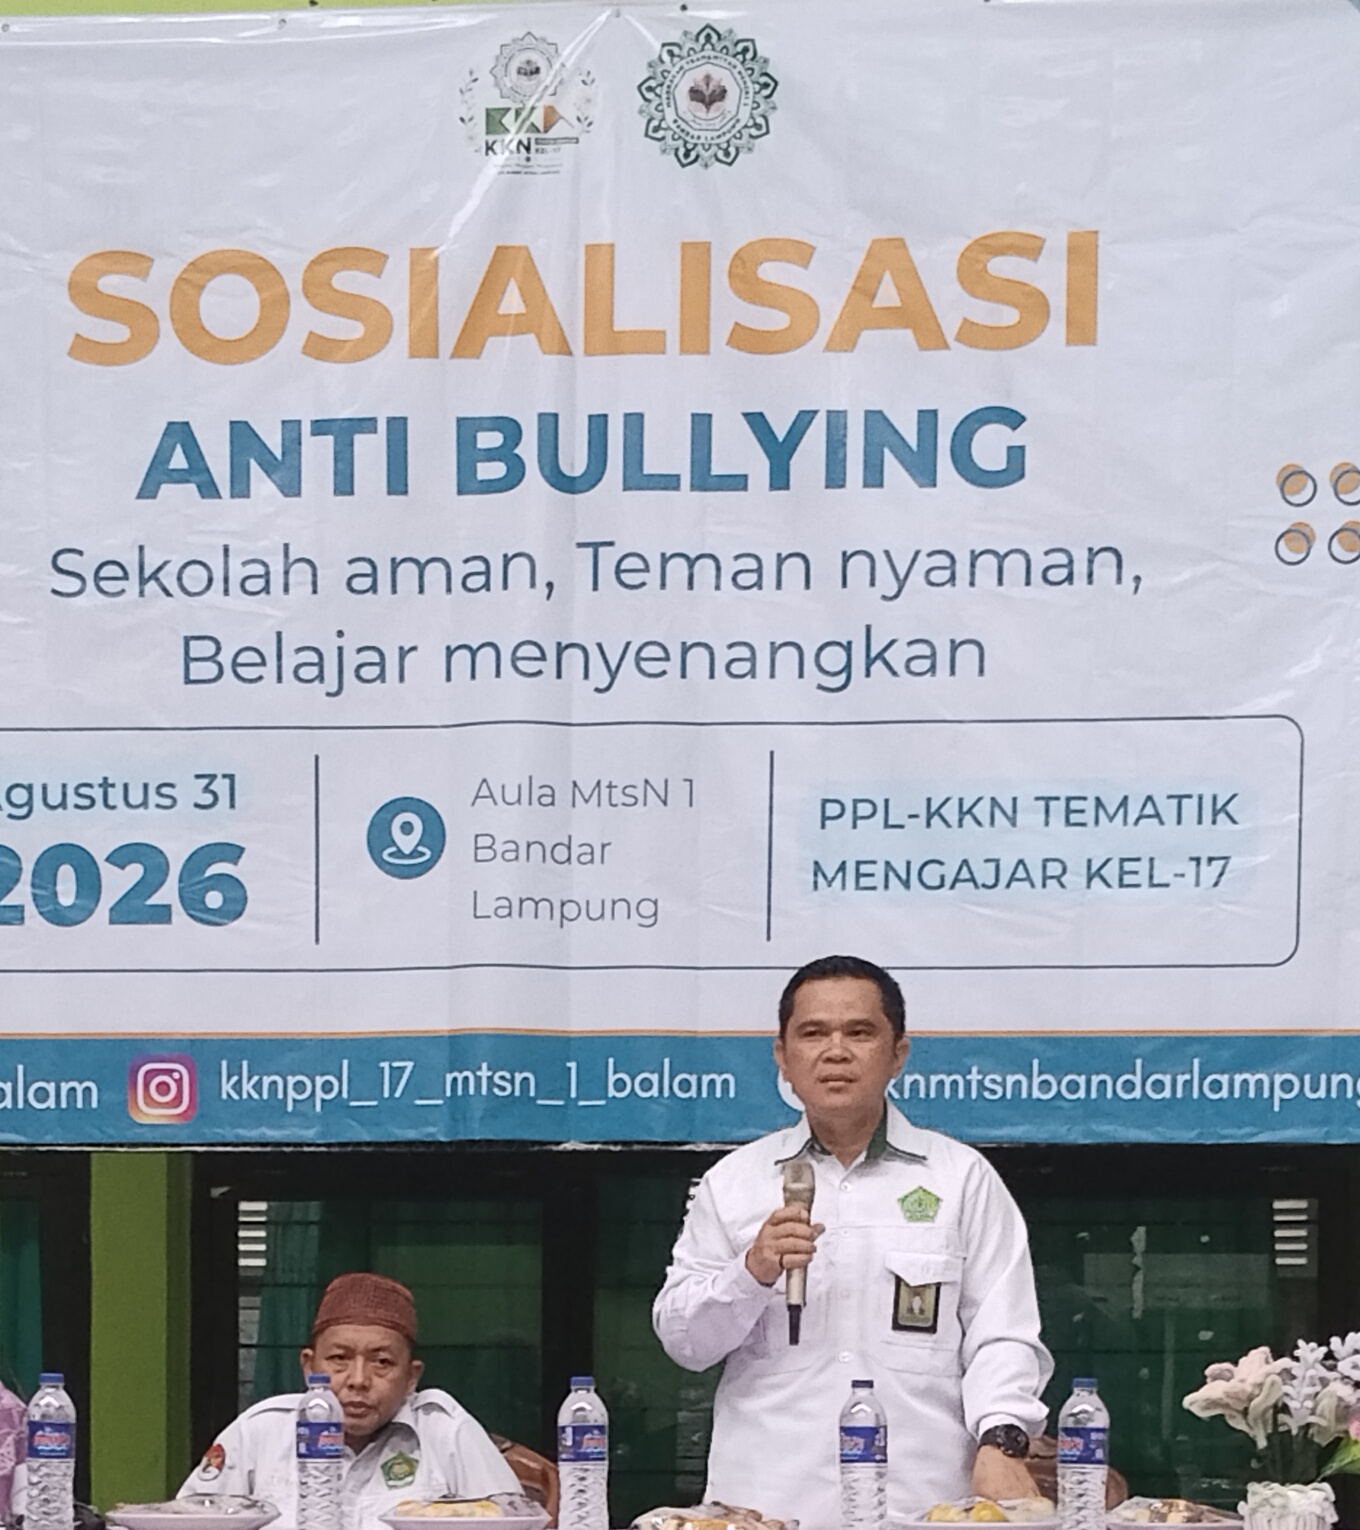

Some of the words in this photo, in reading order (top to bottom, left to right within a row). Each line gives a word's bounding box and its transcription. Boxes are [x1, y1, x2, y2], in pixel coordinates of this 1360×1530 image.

[67, 230, 1101, 368] SOSIALISASI
[136, 416, 410, 501] ANTI
[456, 406, 1028, 498] BULLYING
[51, 543, 320, 600] Sekolah
[346, 552, 556, 602] aman,
[576, 541, 812, 593] Teman
[842, 547, 1143, 603] nyaman,
[184, 630, 419, 699] Belajar
[446, 624, 986, 695] menyenangkan
[194, 774, 237, 812] 31
[471, 776, 557, 809] Aula
[572, 779, 670, 810] MtsN
[683, 778, 695, 809] 1
[821, 797, 1019, 831] PPL-KKN
[1034, 794, 1240, 829] TEMATIK
[474, 834, 613, 867] Bandar
[813, 858, 1069, 893] MENGAJAR
[1087, 856, 1232, 891] KEL-17
[474, 891, 660, 930] Lampung
[222, 1058, 737, 1114] kknppl_17_mtsn_1_balam
